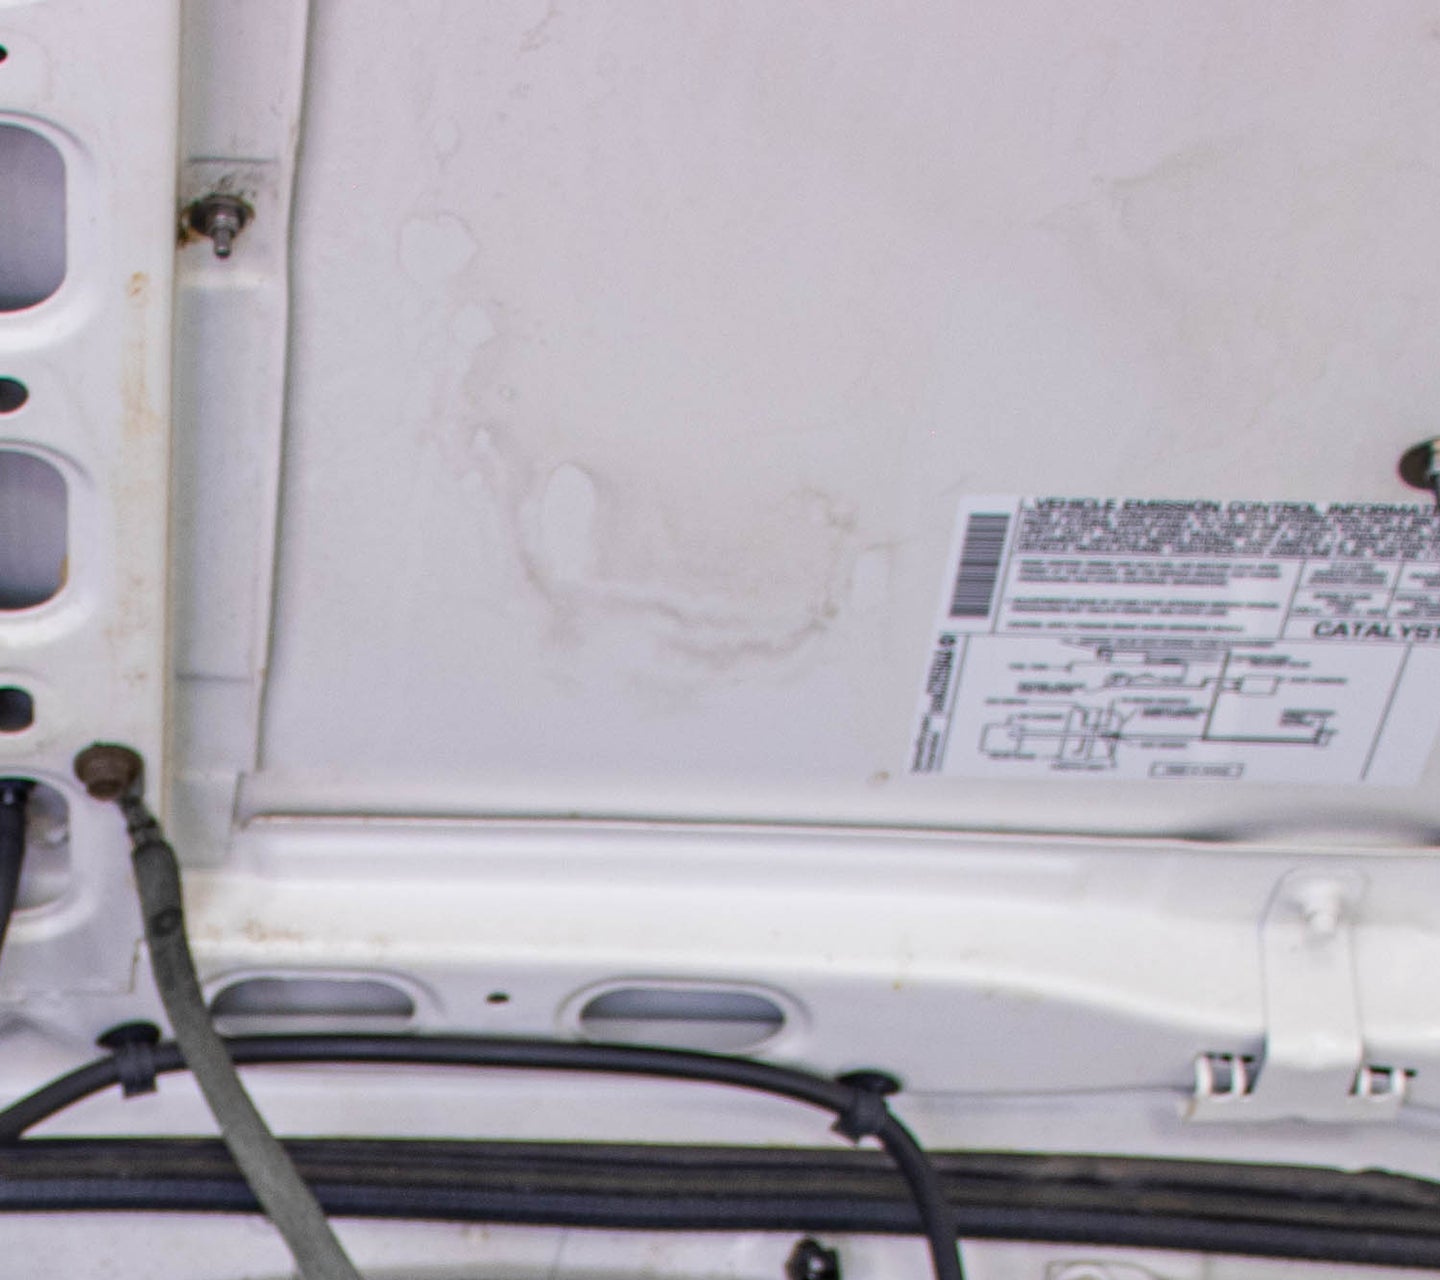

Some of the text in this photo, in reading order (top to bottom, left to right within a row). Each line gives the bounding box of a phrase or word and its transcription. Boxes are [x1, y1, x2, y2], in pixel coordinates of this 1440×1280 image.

[1034, 497, 1117, 511] VEHICLE
[1123, 499, 1220, 513] EMISSION
[1227, 501, 1317, 515] CONTROL
